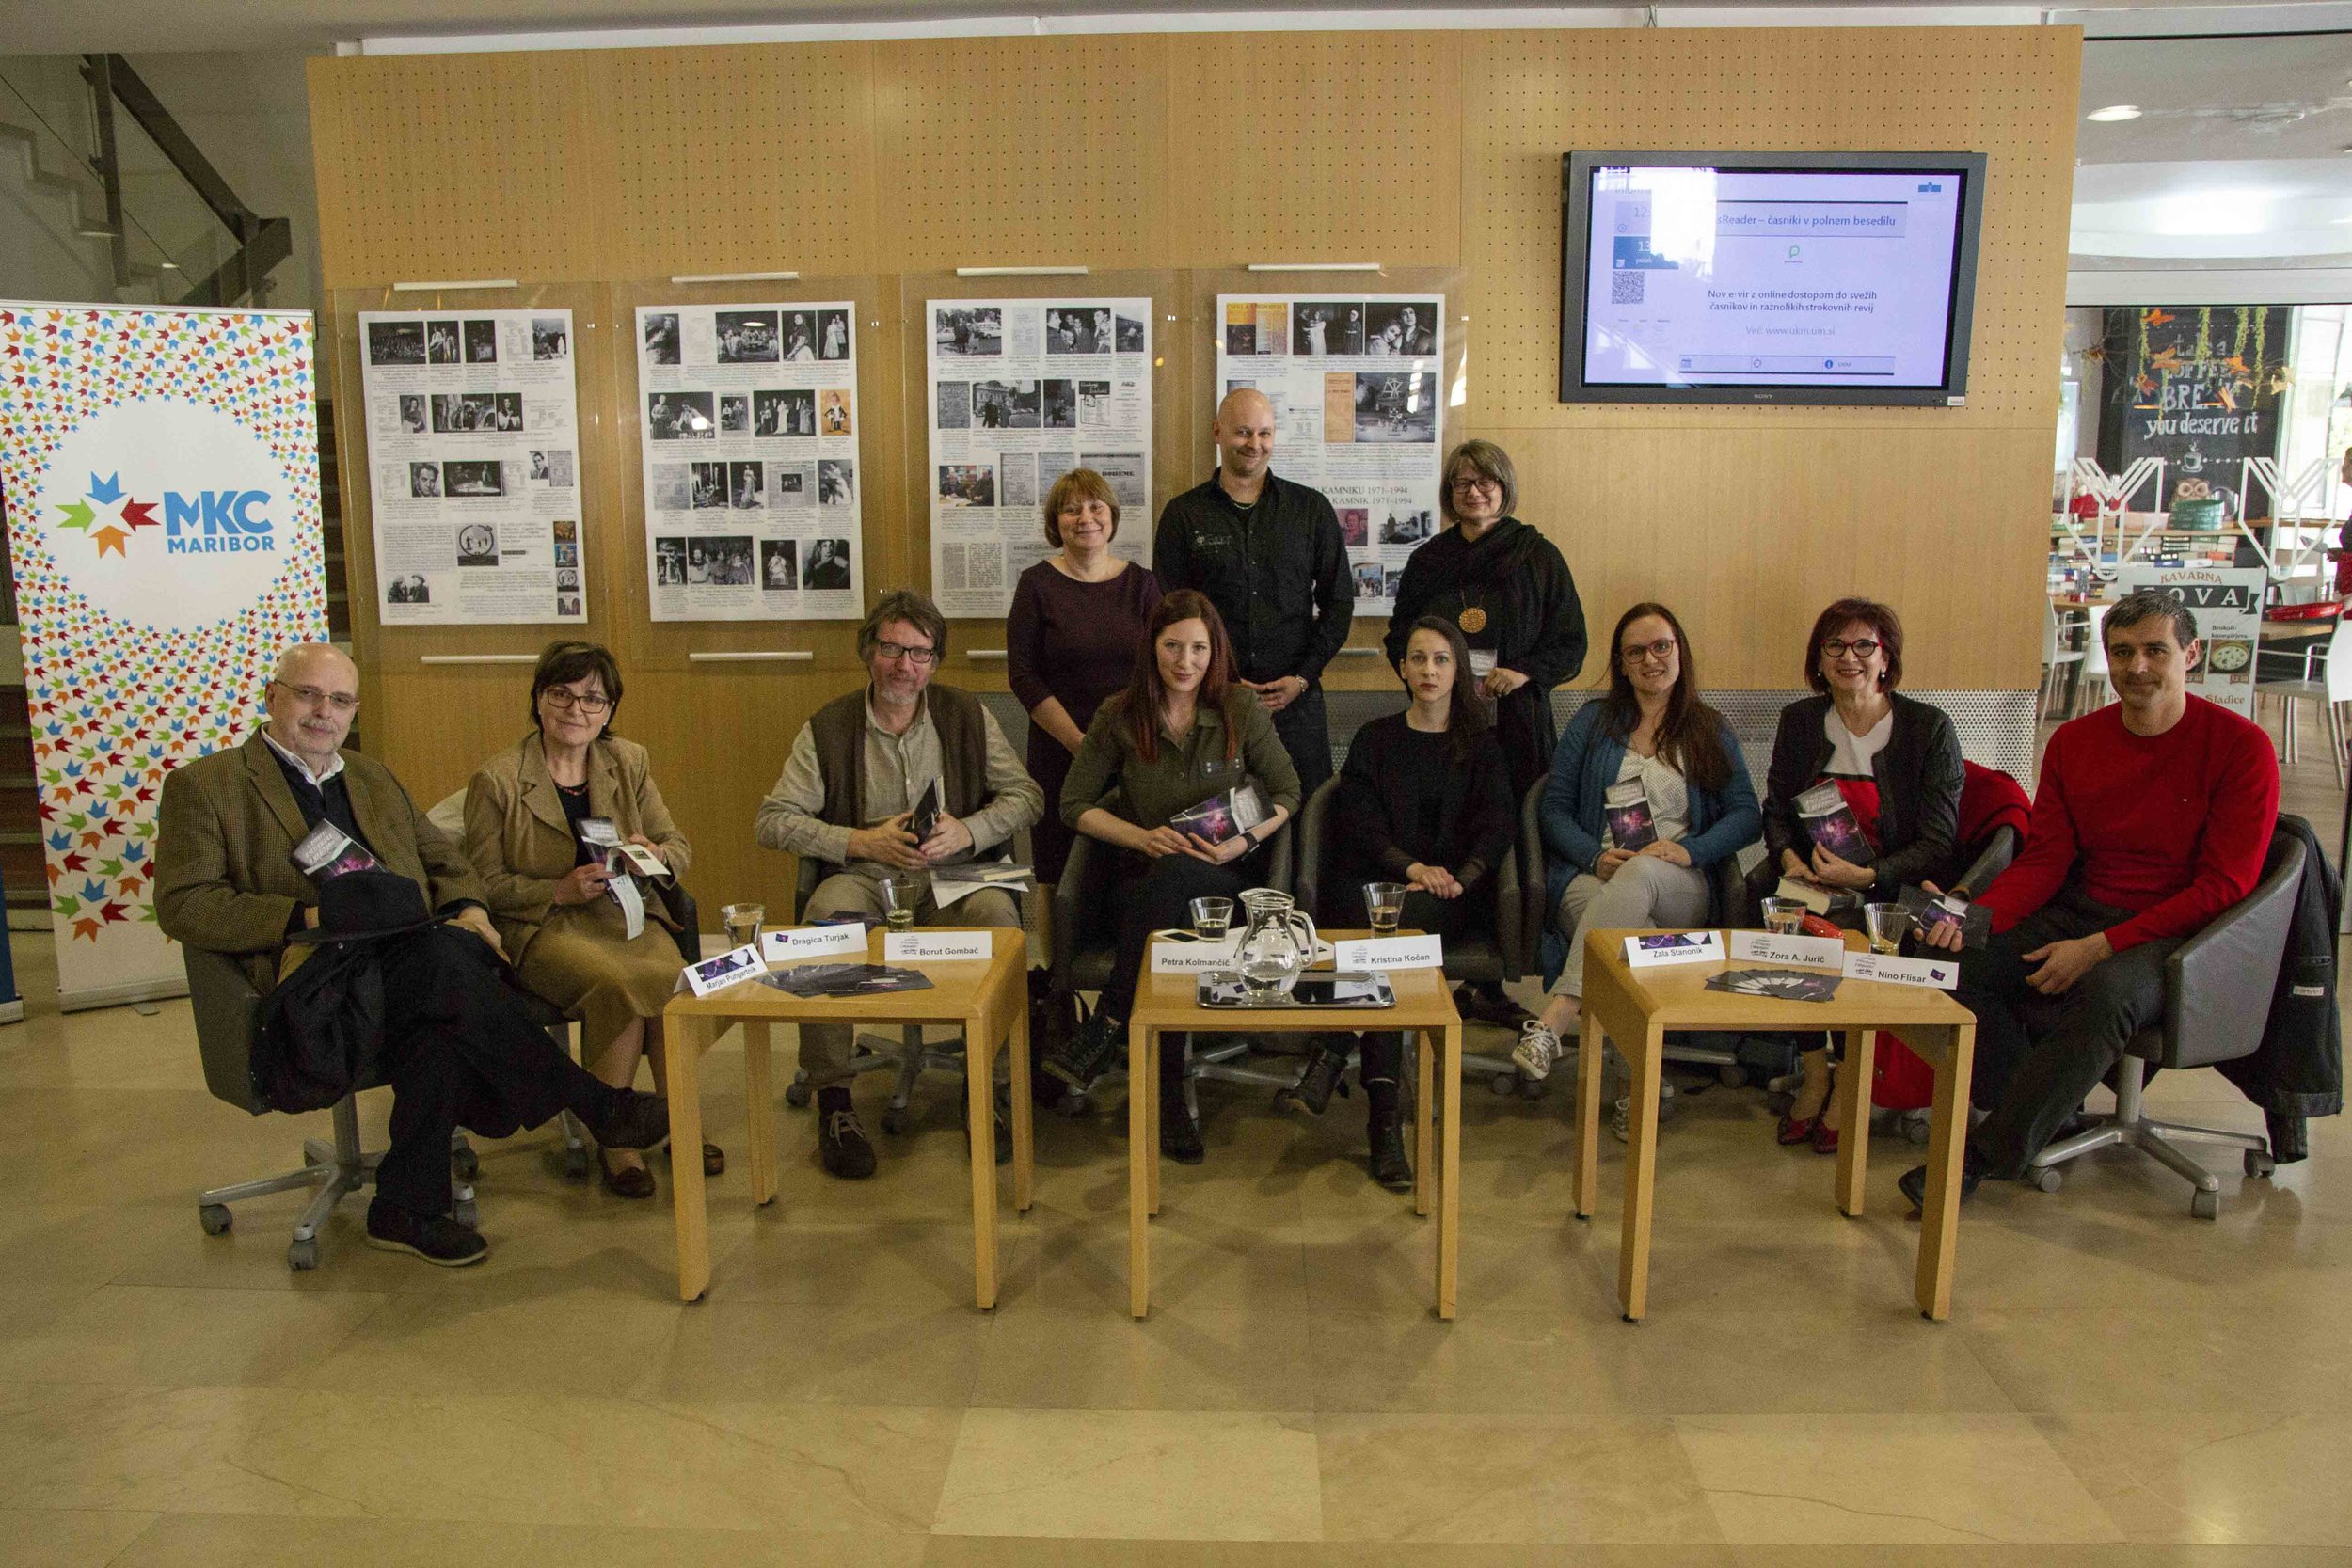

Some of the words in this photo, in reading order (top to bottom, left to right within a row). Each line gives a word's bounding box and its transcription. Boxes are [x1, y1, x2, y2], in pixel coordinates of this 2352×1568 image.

[1716, 214, 1756, 227] sReader
[1768, 214, 1801, 227] časniki
[1804, 217, 1810, 226] v
[1812, 215, 1850, 229] polnem
[1853, 215, 1896, 227] besedilu
[1708, 290, 1726, 298] Nov
[1758, 291, 1787, 299] online
[1788, 291, 1834, 301] dostopom
[1836, 291, 1847, 300] do
[1850, 292, 1877, 300] svežih
[1710, 302, 1748, 310] časnikov
[1750, 303, 1758, 311] in
[1760, 303, 1804, 311] raznolikih
[1805, 303, 1852, 312] strokovnih
[1854, 303, 1874, 313] revij
[2144, 419, 2176, 440] you
[2180, 412, 2240, 435] deserve
[2244, 411, 2258, 435] it
[163, 490, 273, 536] MKC
[167, 535, 276, 554] MARIBOR
[2160, 571, 2222, 584] KAVARNA
[2141, 587, 2240, 605] OVA
[791, 936, 823, 946] Dragica
[825, 933, 850, 943] Turjak
[1653, 950, 1669, 958] Zala
[1671, 948, 1703, 957] Stanonik
[1770, 951, 1789, 960] Zora
[1791, 953, 1801, 961] A.
[706, 977, 726, 990] Marjan
[1878, 971, 1899, 980] Nino
[1900, 974, 1926, 983] Flisar
